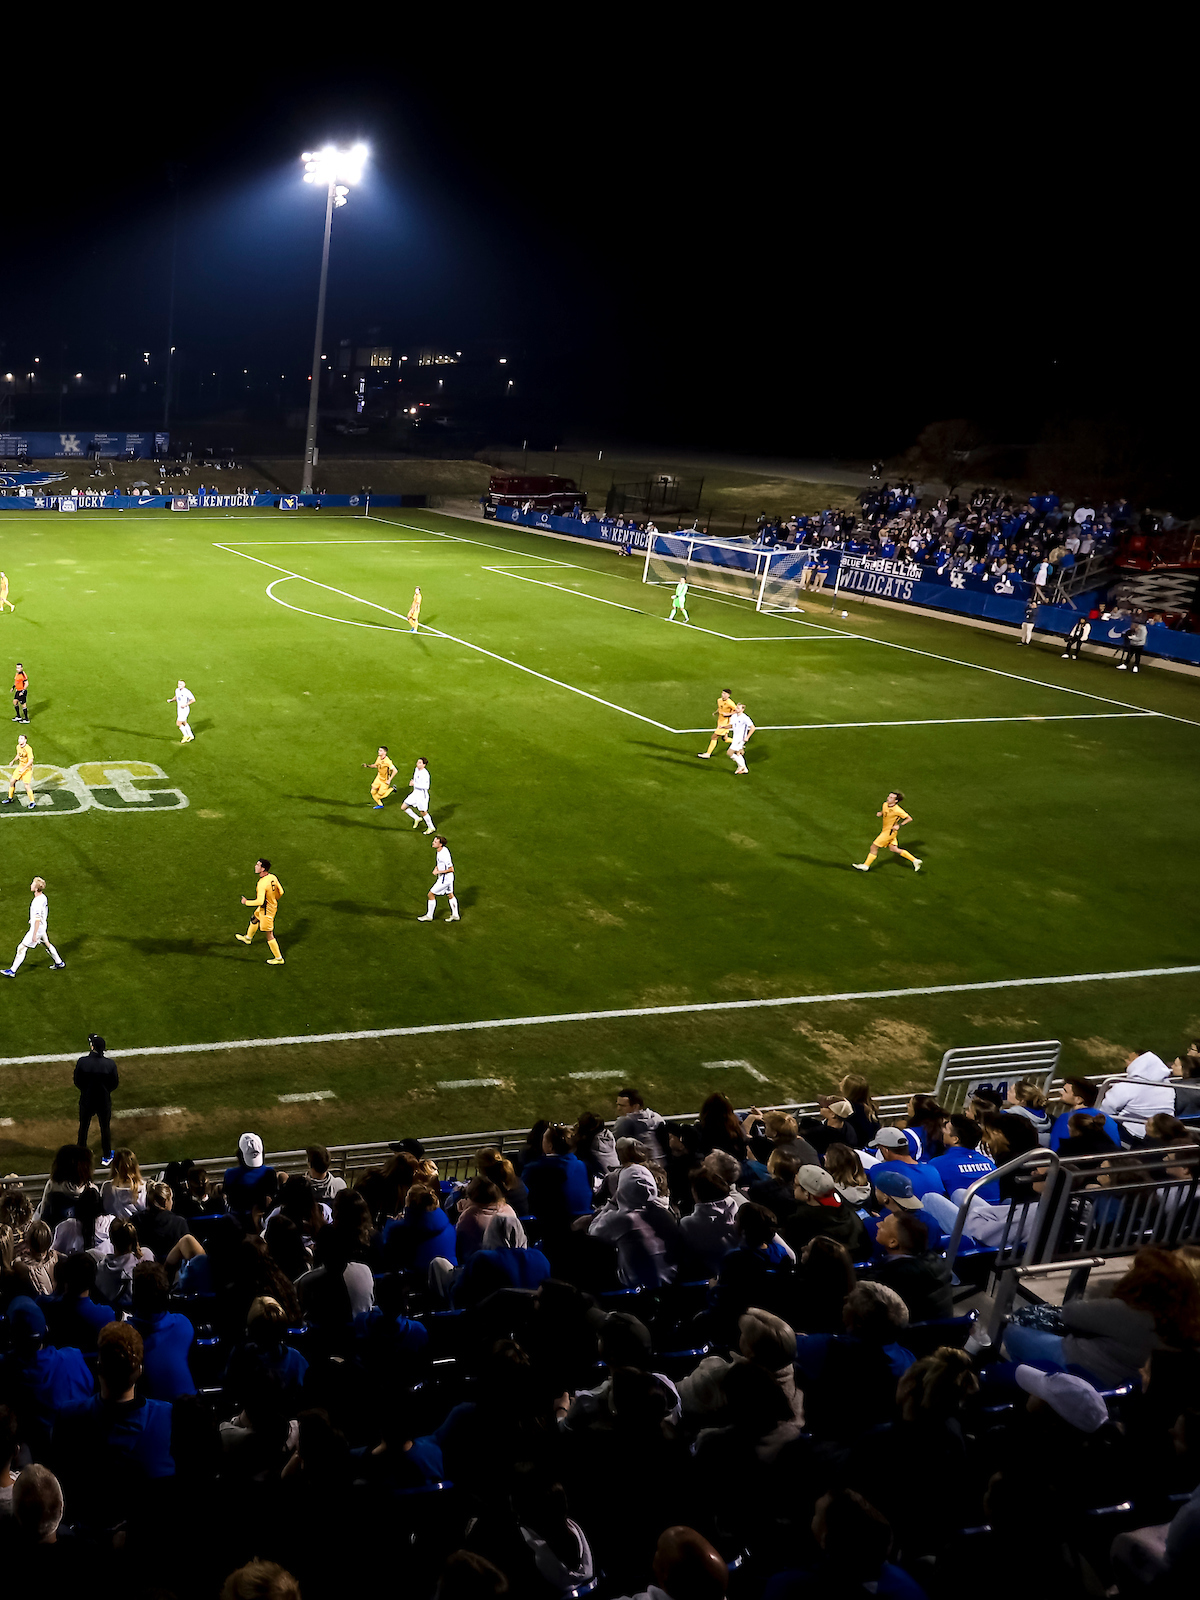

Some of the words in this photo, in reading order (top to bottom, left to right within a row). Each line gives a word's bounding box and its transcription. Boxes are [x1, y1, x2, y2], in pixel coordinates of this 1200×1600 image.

[59, 434, 80, 452] UK
[202, 496, 257, 507] KENTUCKY
[840, 568, 914, 600] WILDCATS
[957, 1162, 992, 1174] KENTUCKY
